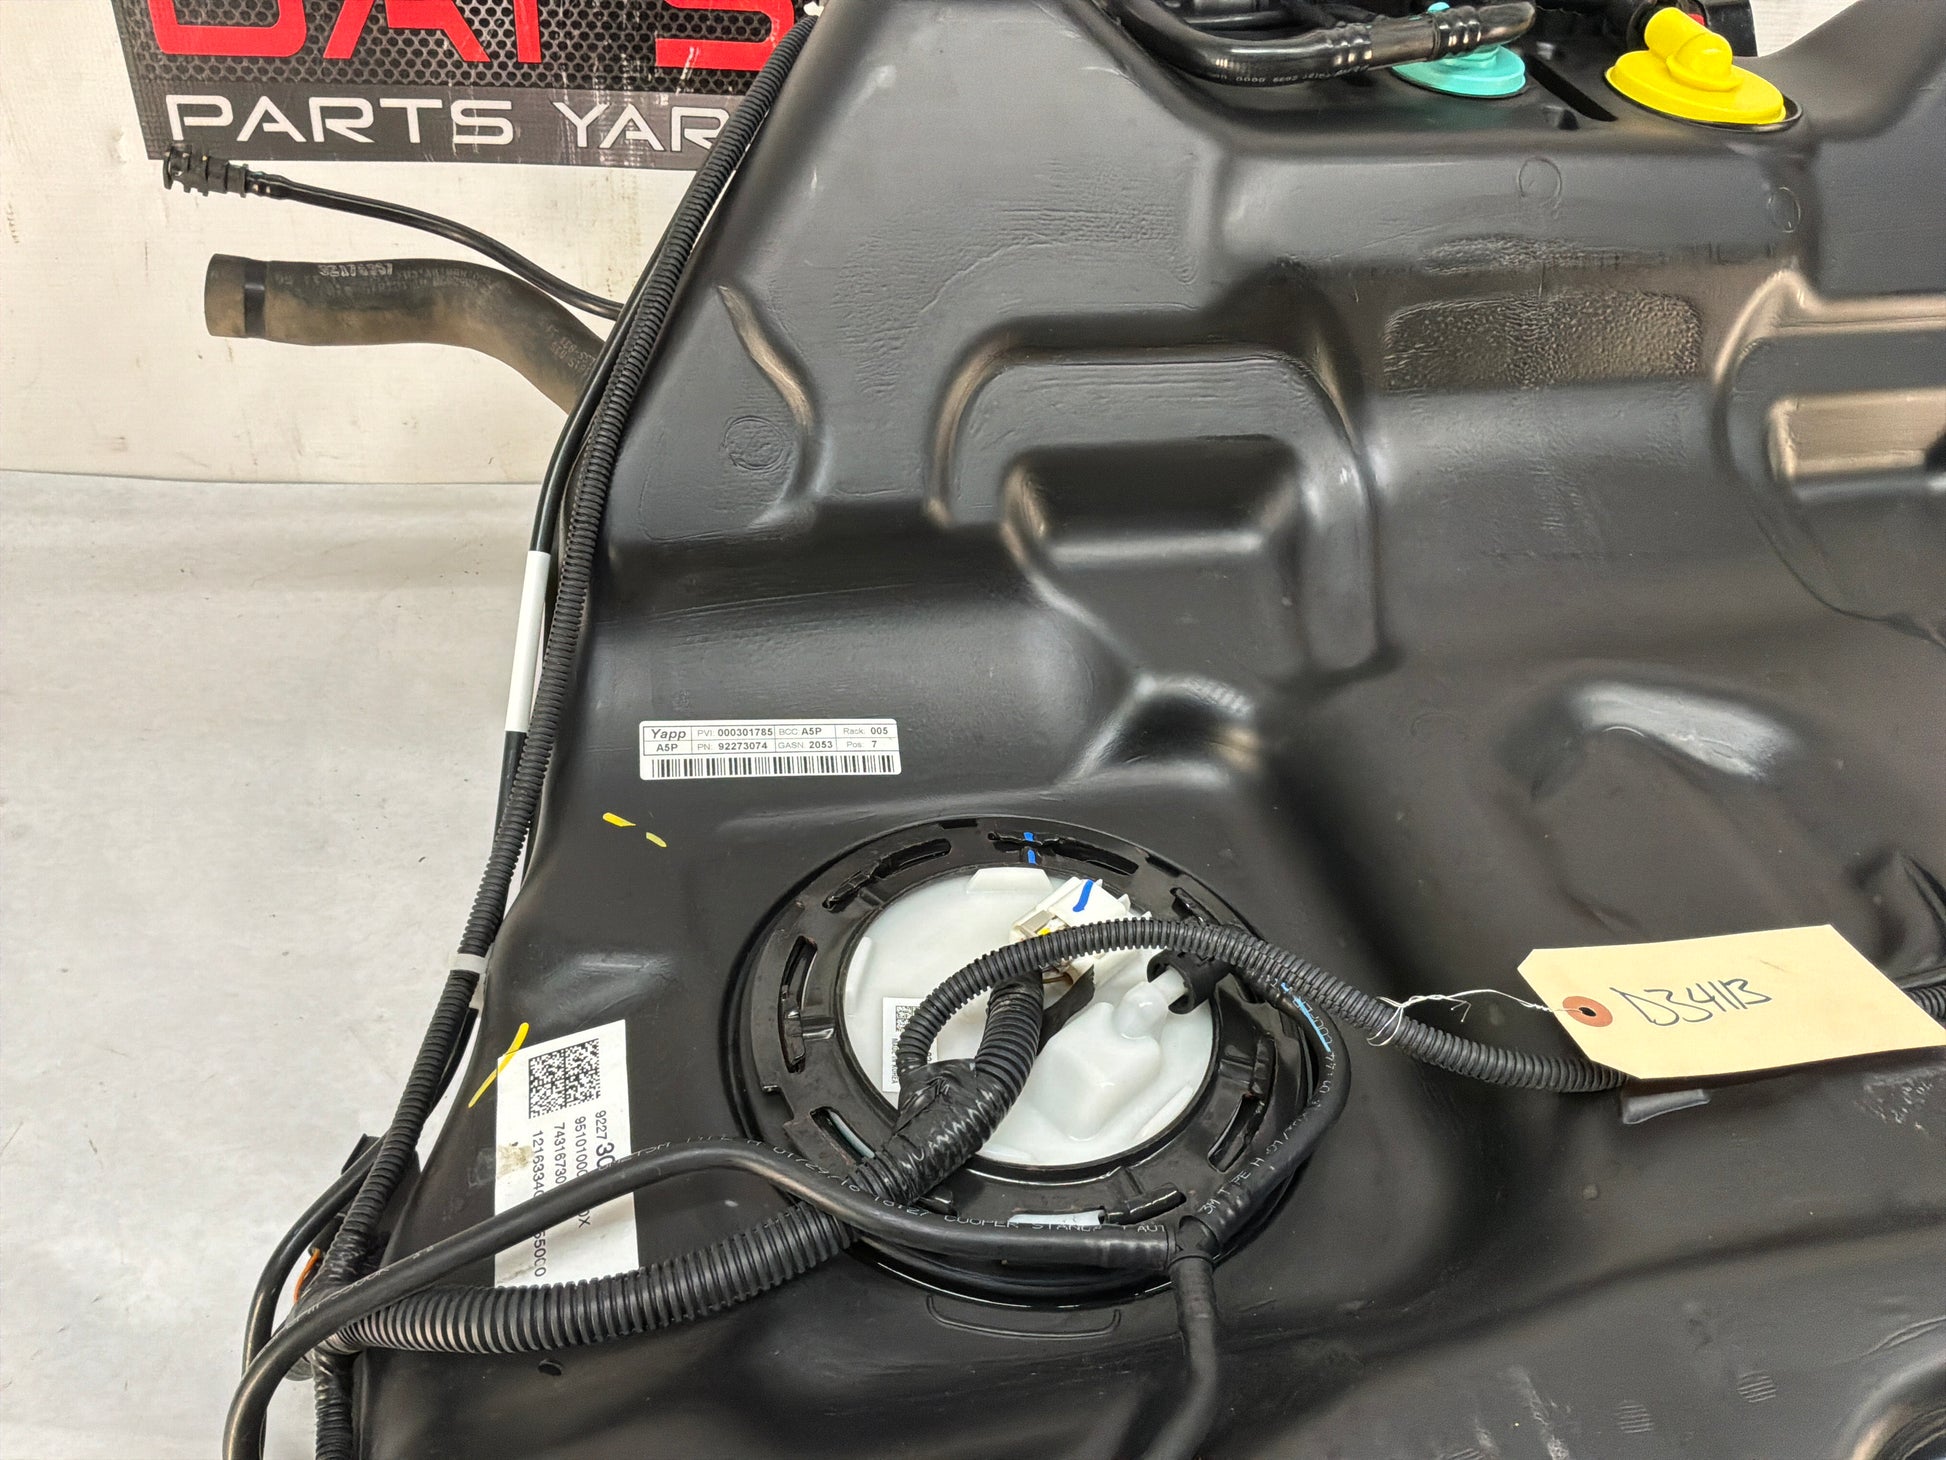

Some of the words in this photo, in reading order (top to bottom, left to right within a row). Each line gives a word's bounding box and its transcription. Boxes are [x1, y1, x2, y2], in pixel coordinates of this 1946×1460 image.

[165, 94, 512, 146] PARTS
[651, 728, 687, 741] Yapp
[717, 728, 773, 737] 000301785
[801, 727, 822, 736] A5P
[870, 727, 888, 735] 005
[656, 743, 678, 752] A5P
[718, 741, 768, 751] 92273074
[809, 740, 833, 749] 2053
[871, 740, 878, 748] 7
[554, 1122, 567, 1185] 74316730
